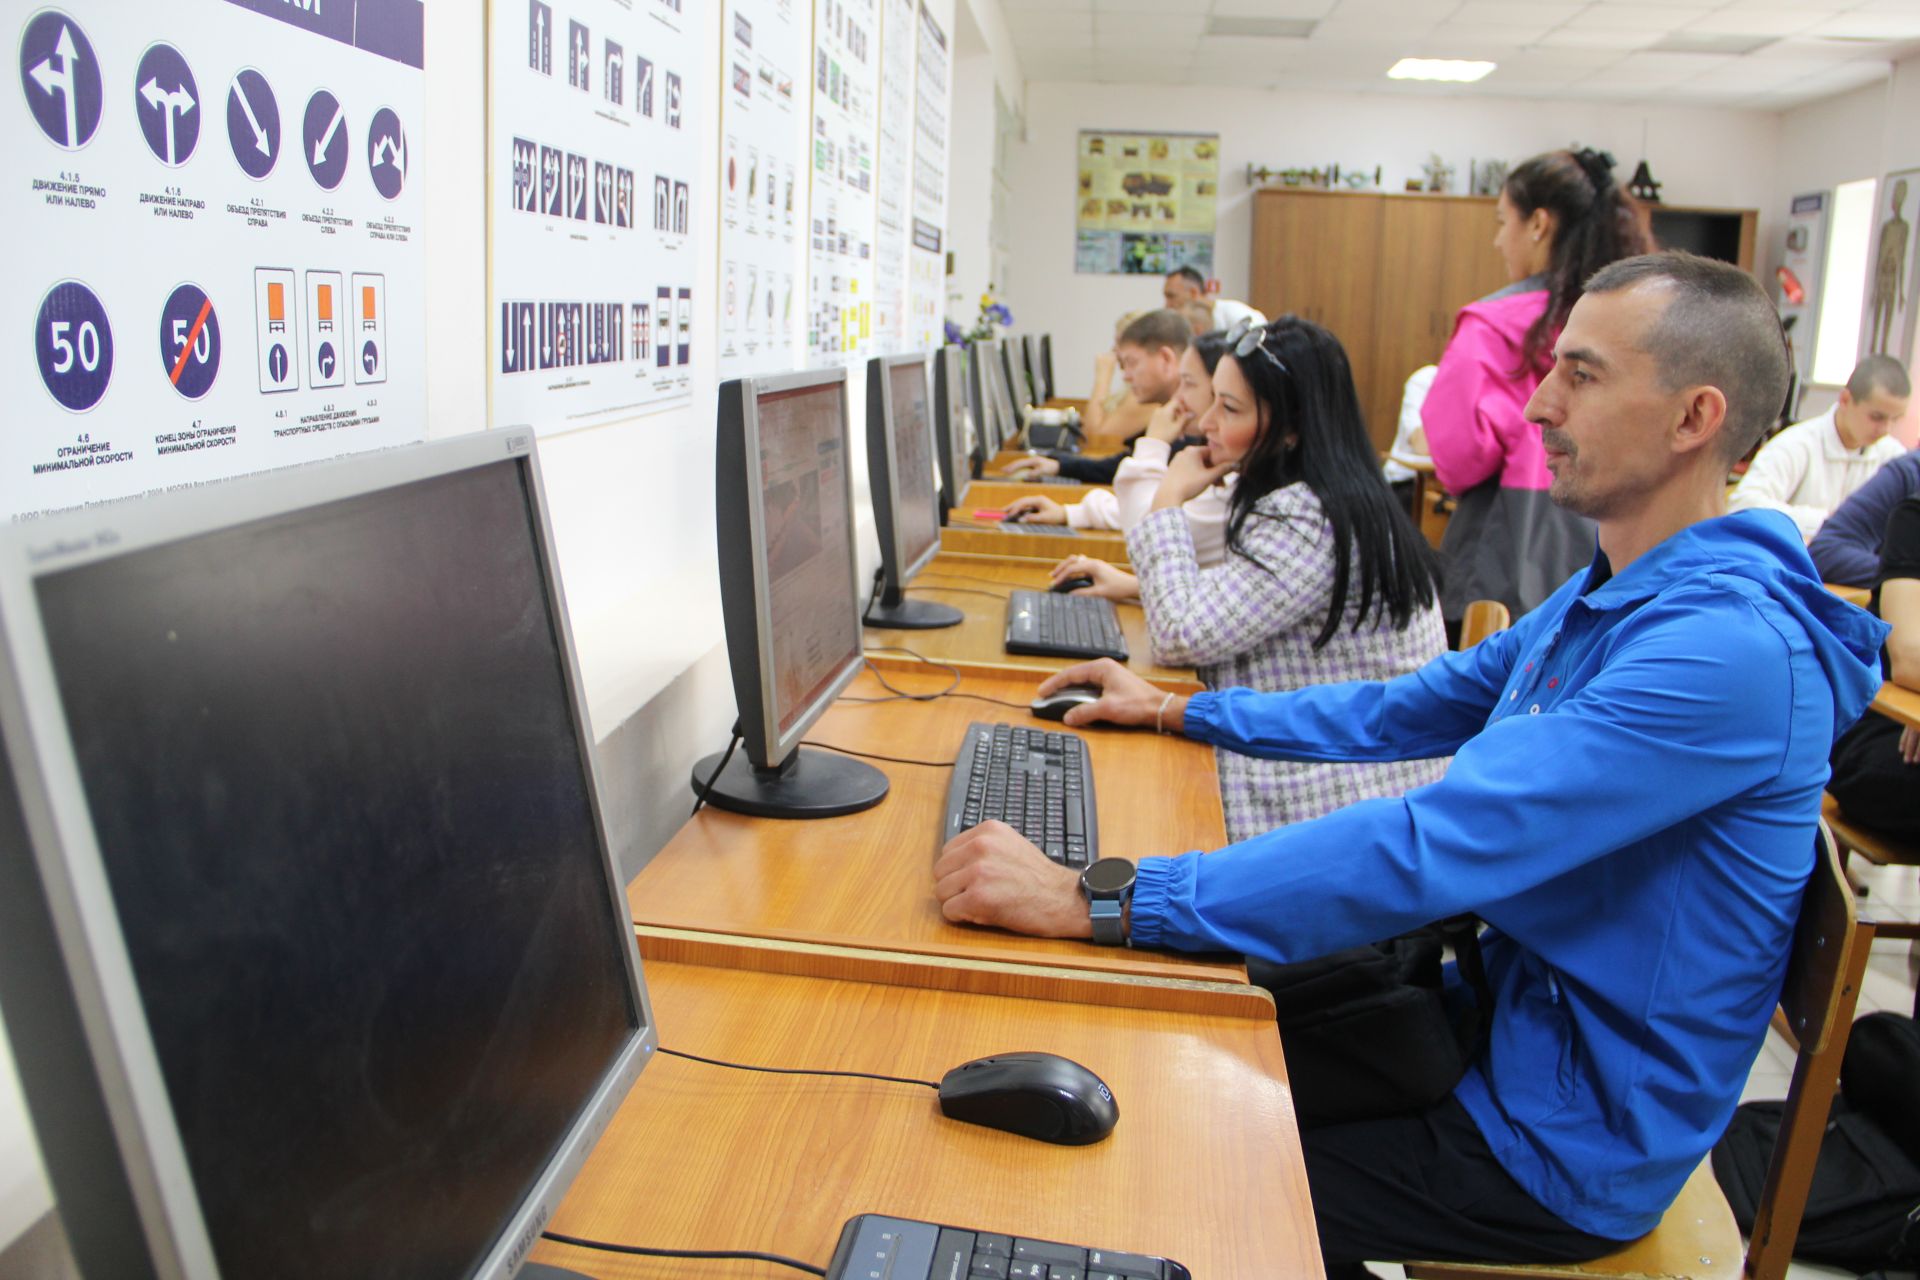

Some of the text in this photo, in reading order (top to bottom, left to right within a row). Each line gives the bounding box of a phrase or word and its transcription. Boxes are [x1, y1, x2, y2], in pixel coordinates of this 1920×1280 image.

[60, 171, 80, 183] 4.1.5
[32, 179, 106, 198] ДВИЖЕНИЕ ПРЯМО
[45, 194, 96, 209] ИЛИ НАЛЕВО
[139, 193, 206, 209] ДВИЖЕНИЕ НАПРАВО
[154, 207, 194, 220] ИЛИ НАЛЕВО
[226, 203, 287, 219] ОБЪЕЗД ПРЕПЯТСТВИЯ
[302, 213, 321, 223] ОБЪЕЗД
[247, 217, 268, 228] СПРАВА
[320, 225, 336, 235] СЛЕВА
[51, 320, 100, 373] 50
[172, 319, 210, 364] 50
[192, 420, 202, 429] 4.7
[300, 409, 357, 424] НАПРАВЛЕНИЕ ДВИЖЕНИЯ
[155, 425, 236, 444] КОНЕЦ ЗОНЫ ОГРАНИЧЕНИЯ
[273, 426, 312, 438] ТРАНСПОРТНЫХ
[312, 422, 333, 433] СРЕДСТВ
[337, 418, 361, 429] ОПАСНЫМИ
[361, 415, 380, 426] ГРУЗАМИ
[77, 433, 90, 444] 4.6
[157, 436, 236, 456] МИНИМАЛЬНОЙ СКОРОСТИ
[57, 442, 111, 458] ОГРАНИЧЕНИЕ
[33, 451, 133, 474] МИНИМАЛЬНОЙ СКОРОСТИ
[507, 1205, 548, 1275] SAMSUNG
